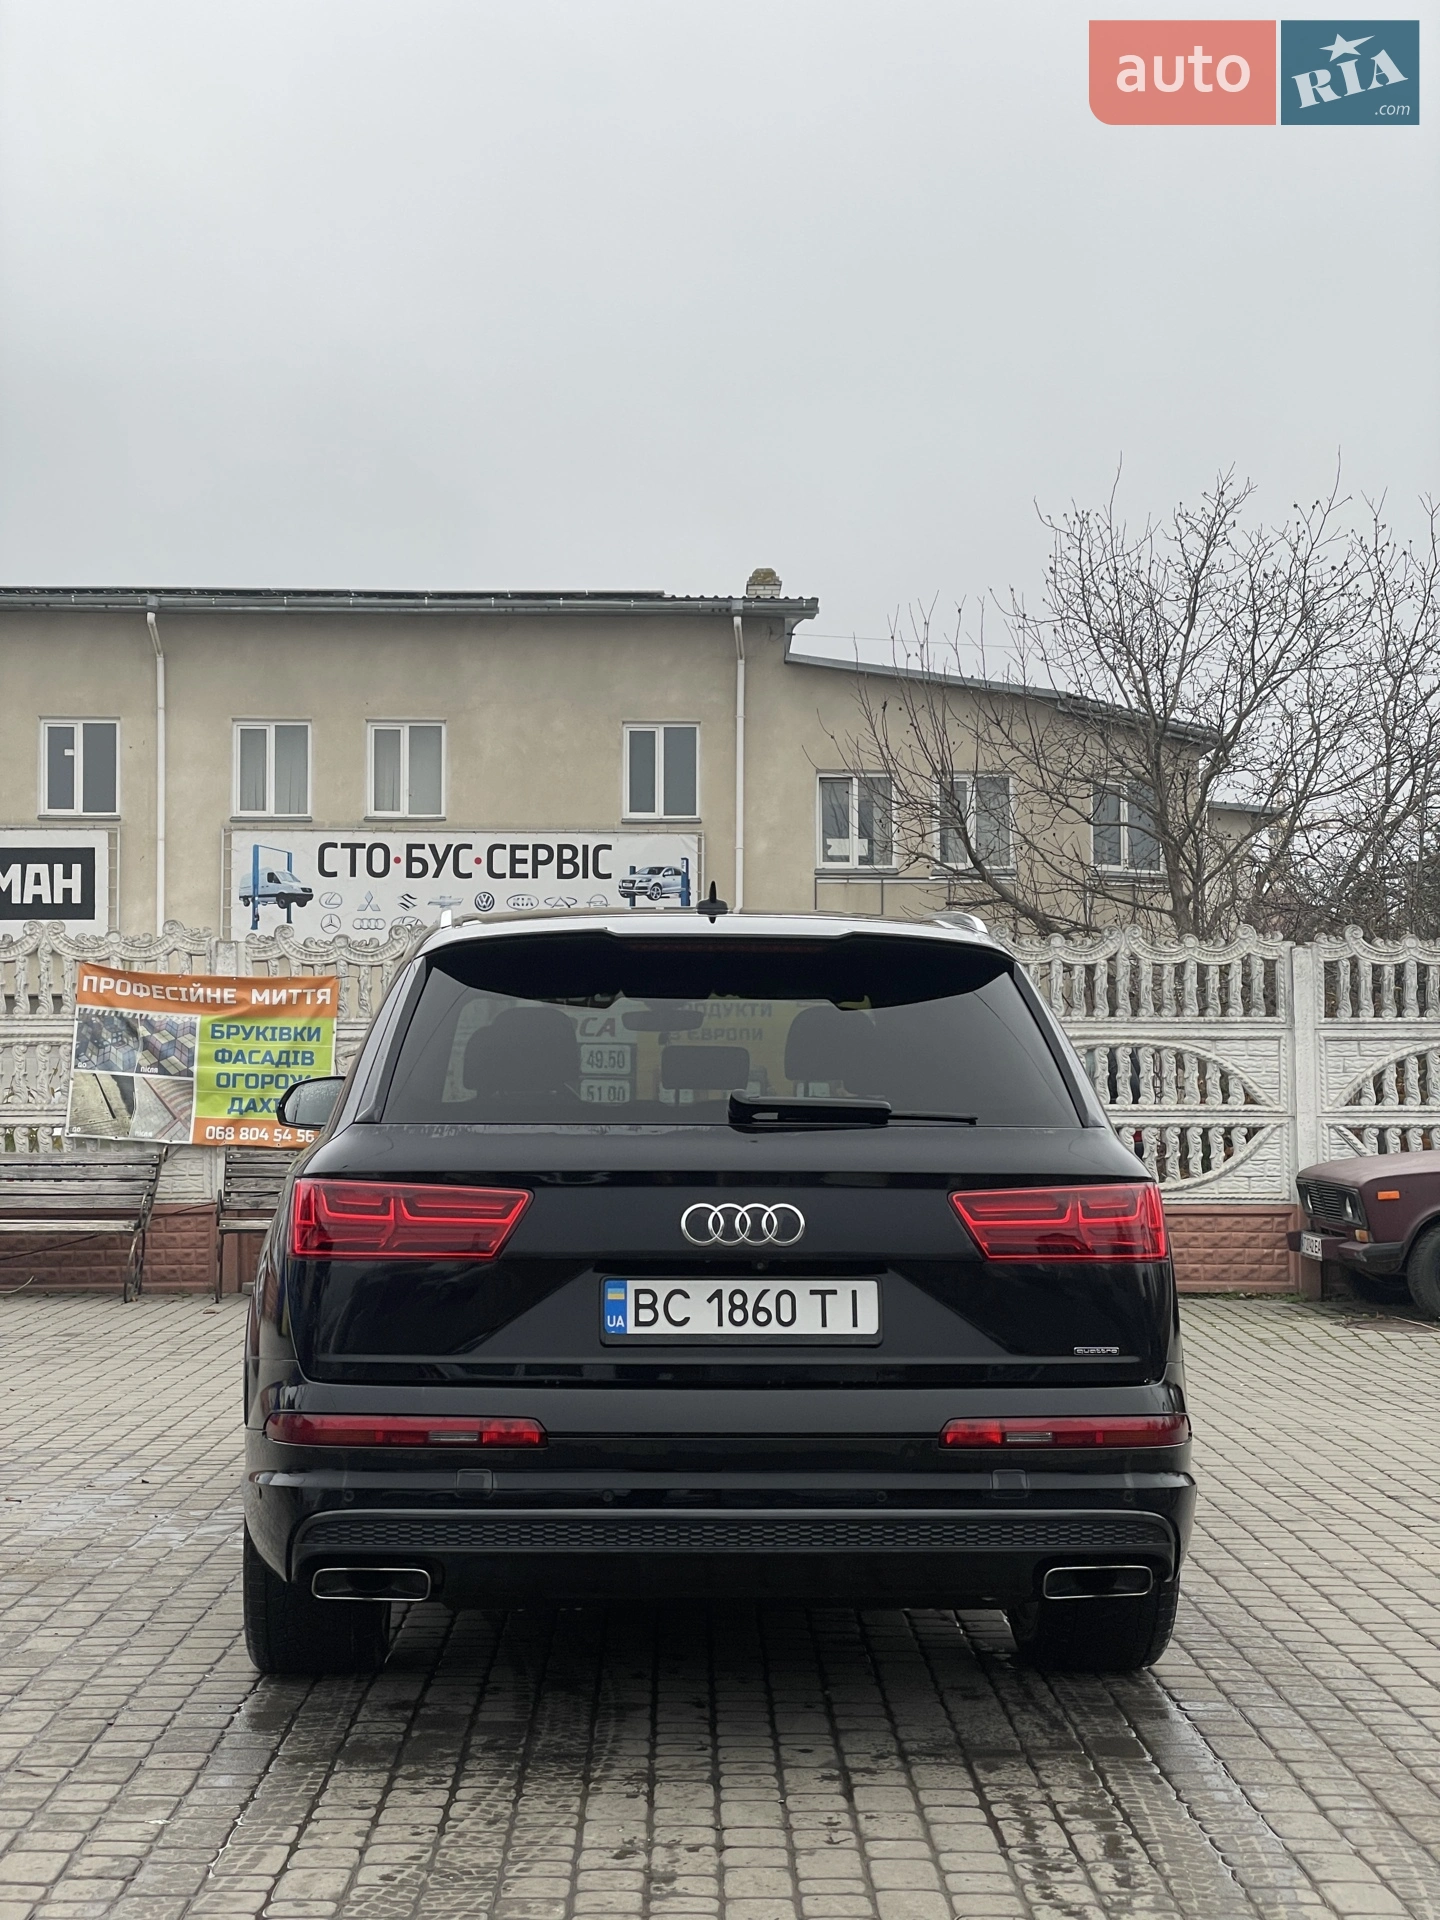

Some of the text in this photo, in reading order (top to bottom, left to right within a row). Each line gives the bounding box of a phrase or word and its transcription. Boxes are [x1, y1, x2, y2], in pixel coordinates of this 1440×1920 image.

[82, 975, 331, 1005] ПРОФЕСІЙНЕ МИТТЯ
[210, 1023, 321, 1042] БРУКІВКИ
[214, 1048, 315, 1068] ФАСАДІВ
[205, 1125, 315, 1143] 068 804 54 56
[607, 1315, 625, 1328] UA
[634, 1288, 691, 1327] BC
[706, 1288, 797, 1327] 1860
